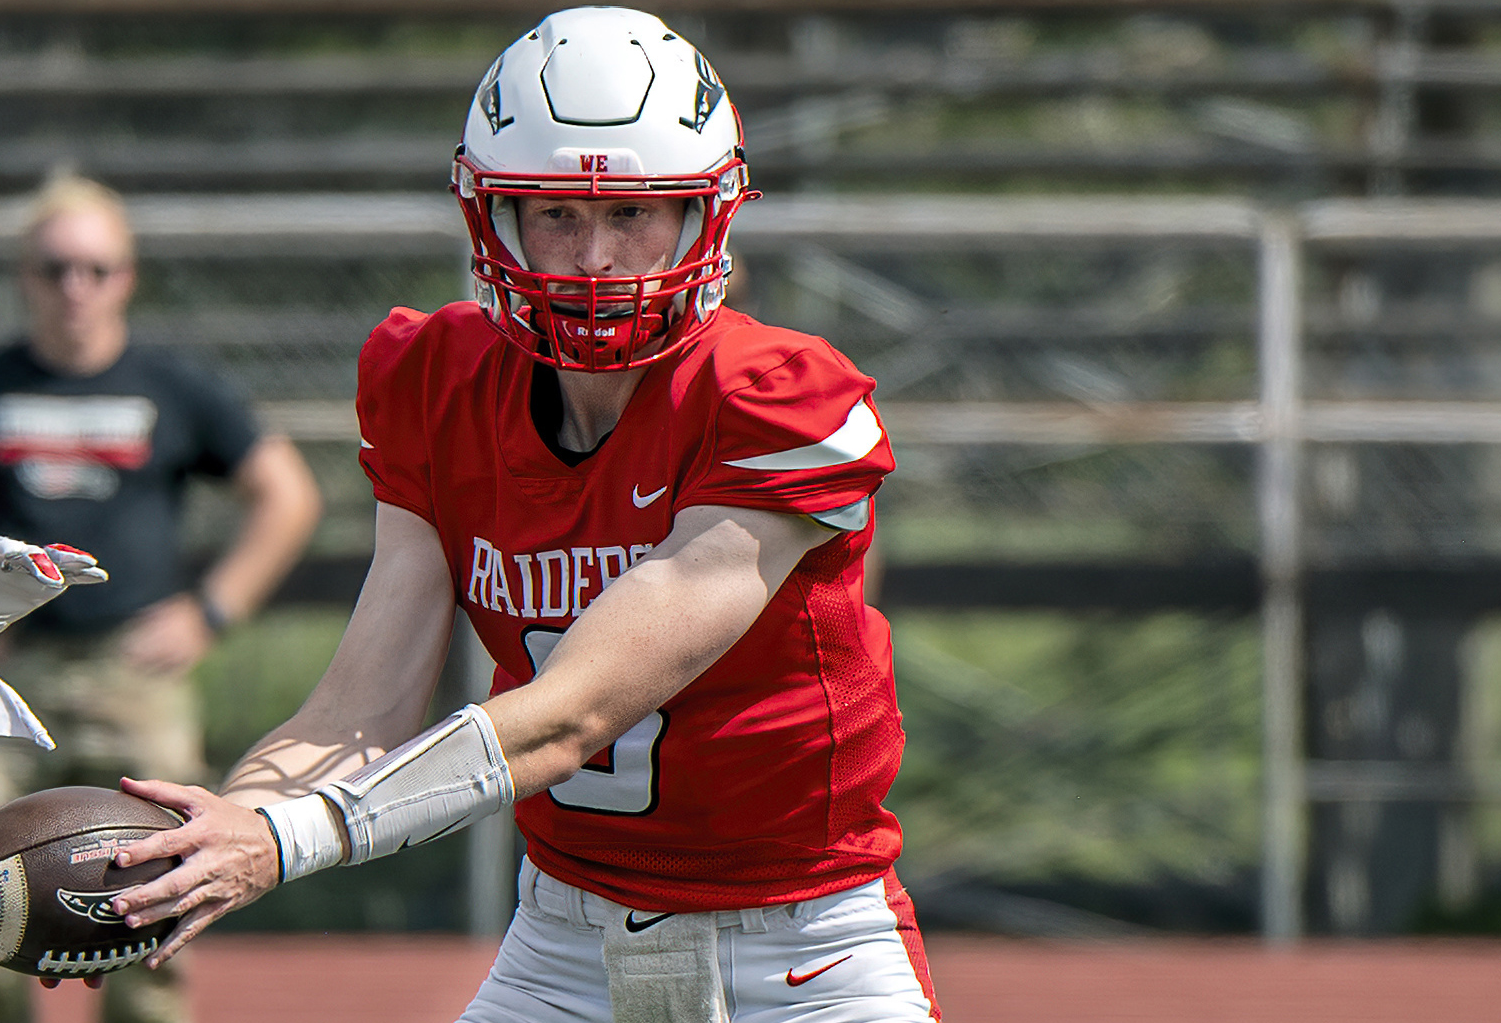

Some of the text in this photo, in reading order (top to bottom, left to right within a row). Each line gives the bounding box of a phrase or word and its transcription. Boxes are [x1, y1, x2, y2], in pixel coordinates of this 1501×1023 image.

[580, 154, 608, 172] WE
[578, 326, 616, 337] Ridell
[468, 536, 653, 618] RAIDER
